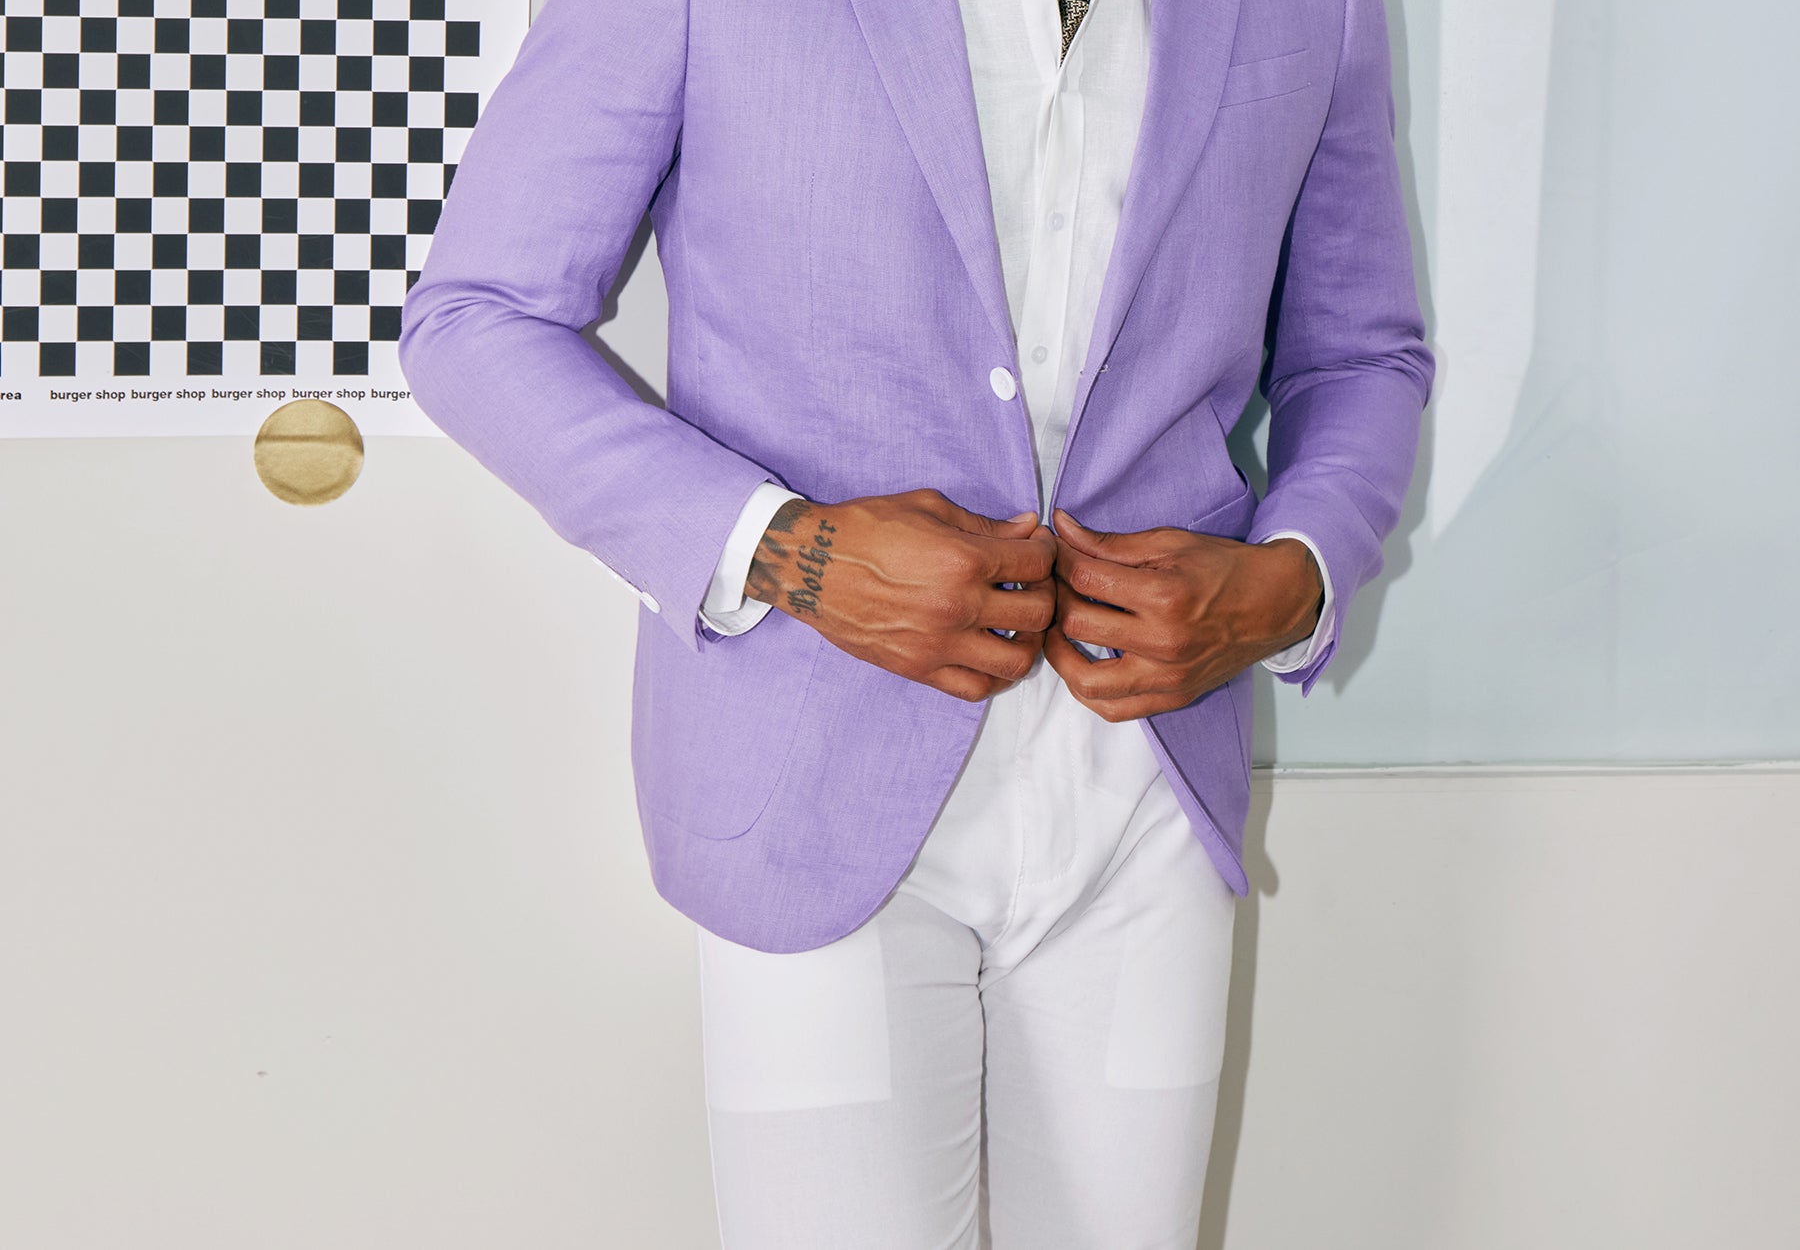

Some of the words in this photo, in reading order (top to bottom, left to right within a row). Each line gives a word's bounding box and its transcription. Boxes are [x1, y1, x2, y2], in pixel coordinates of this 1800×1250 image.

[49, 389, 93, 403] burger
[95, 389, 126, 402] shop
[130, 389, 173, 403] burger
[176, 388, 206, 402] shop
[211, 388, 253, 402] burger
[256, 388, 287, 401] shop
[291, 388, 333, 401] burger
[336, 388, 366, 401] shop
[370, 388, 411, 401] burger
